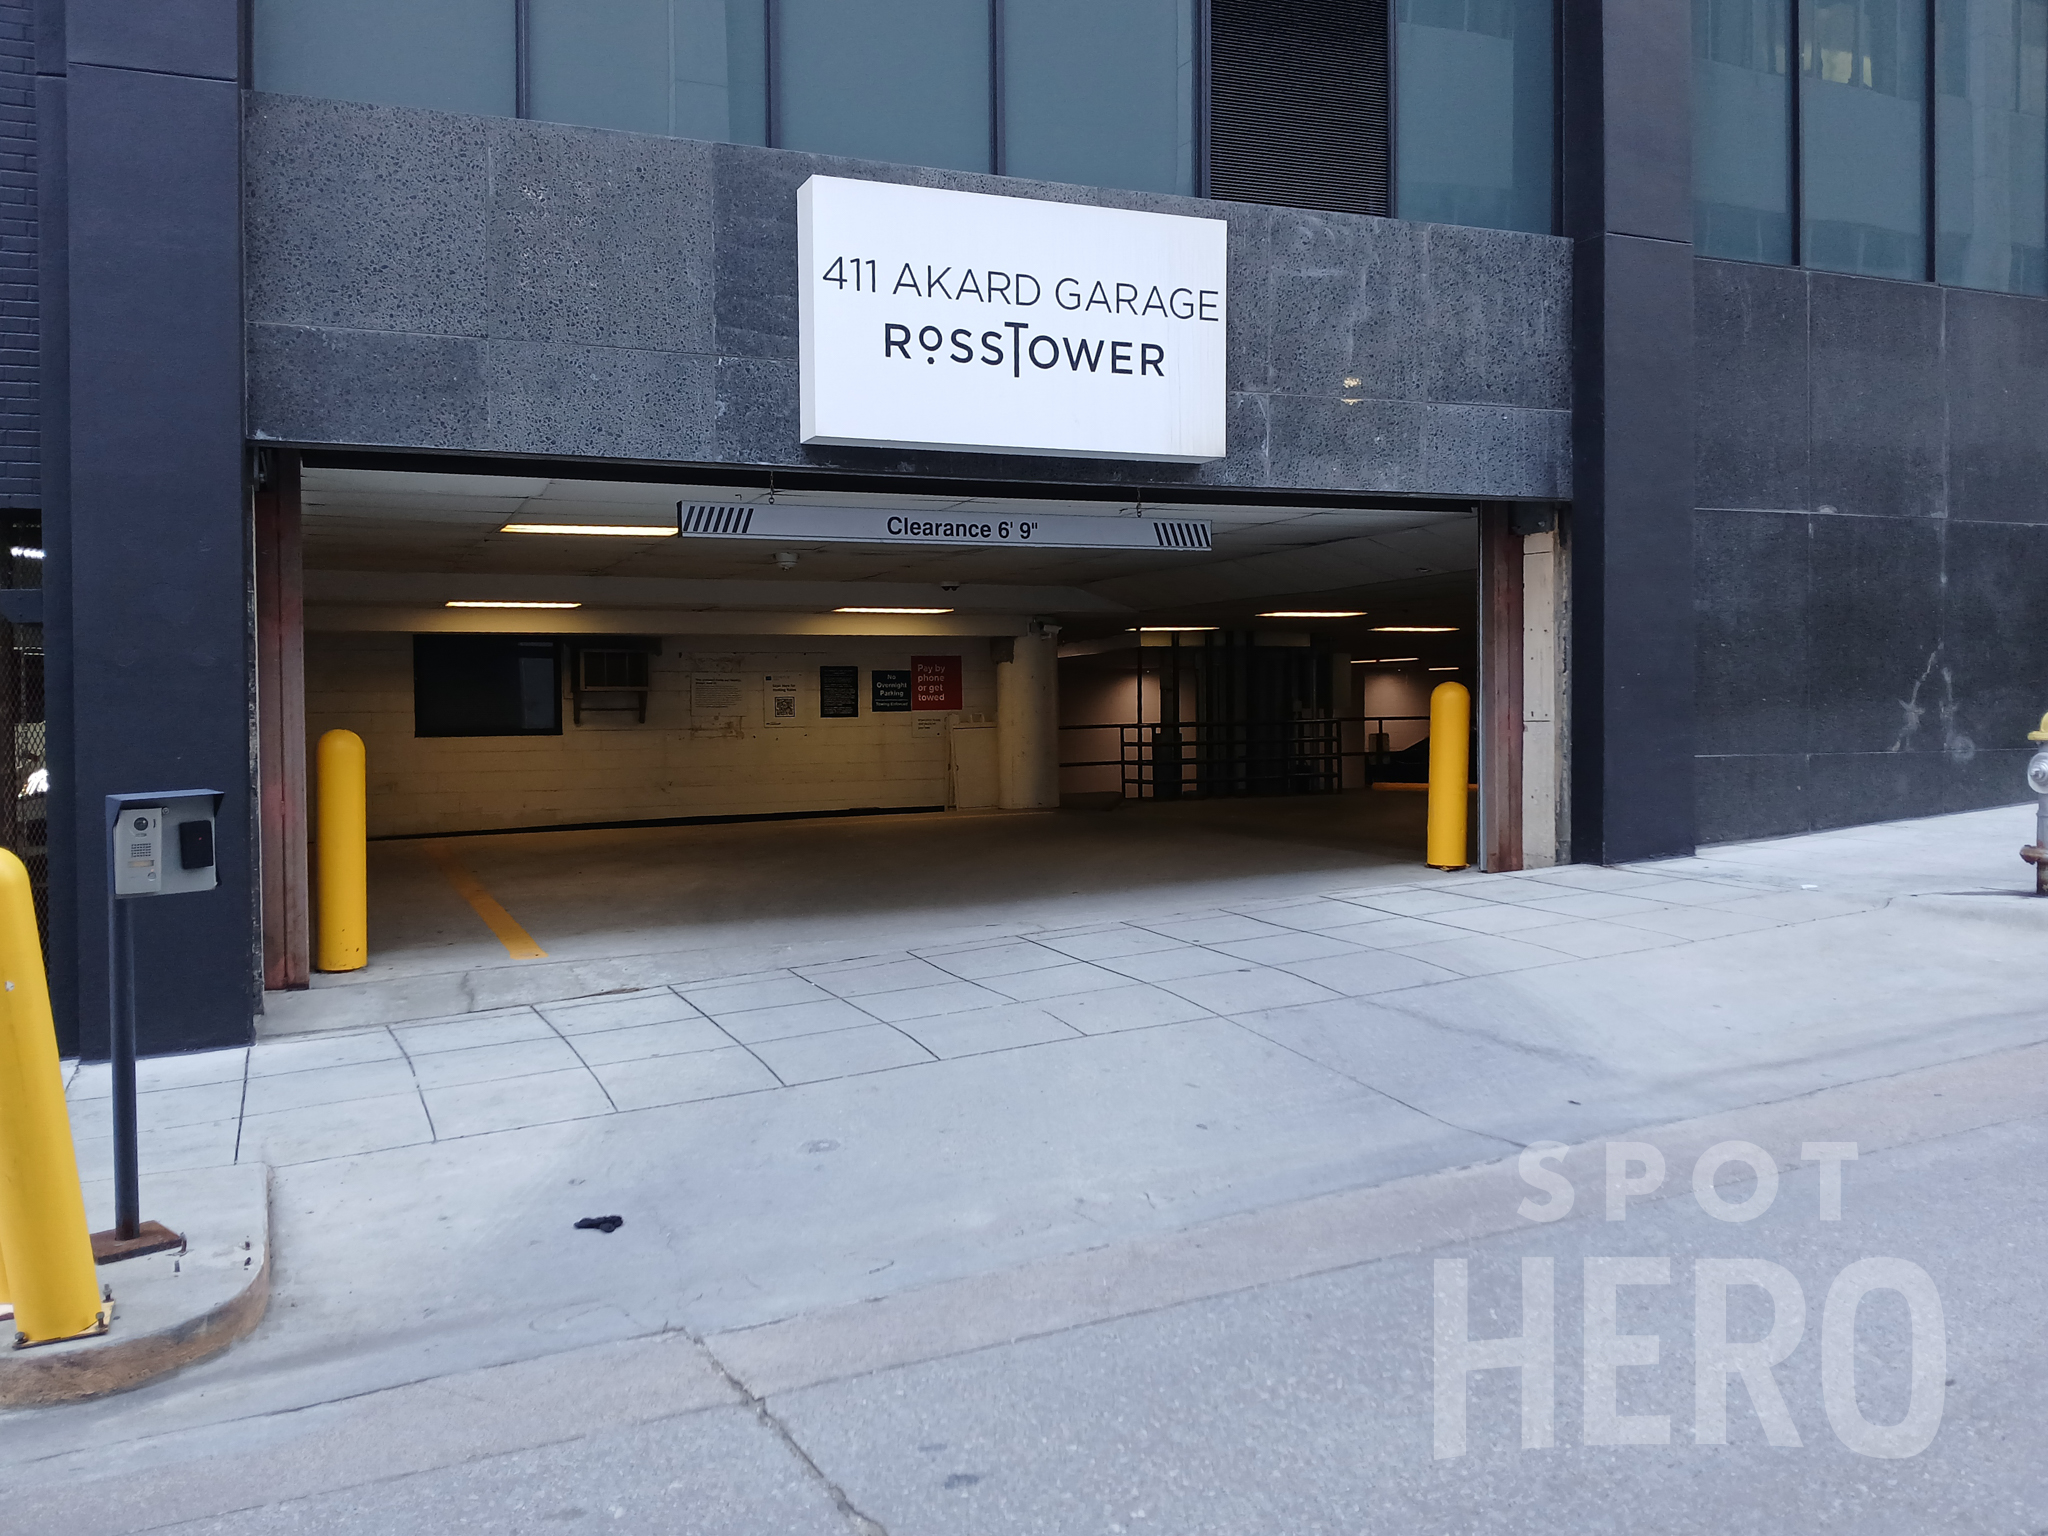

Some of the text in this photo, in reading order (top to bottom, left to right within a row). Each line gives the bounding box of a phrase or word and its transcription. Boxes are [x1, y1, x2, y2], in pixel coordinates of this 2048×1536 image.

[822, 256, 1219, 322] 411 AKARD GARAGE
[887, 516, 1038, 540] Clearance 6' 9"
[917, 664, 945, 674] Pay by
[917, 674, 945, 683] phone
[876, 681, 907, 690] Overnight
[929, 684, 943, 693] get
[879, 690, 904, 698] Parking
[918, 693, 945, 702] towed
